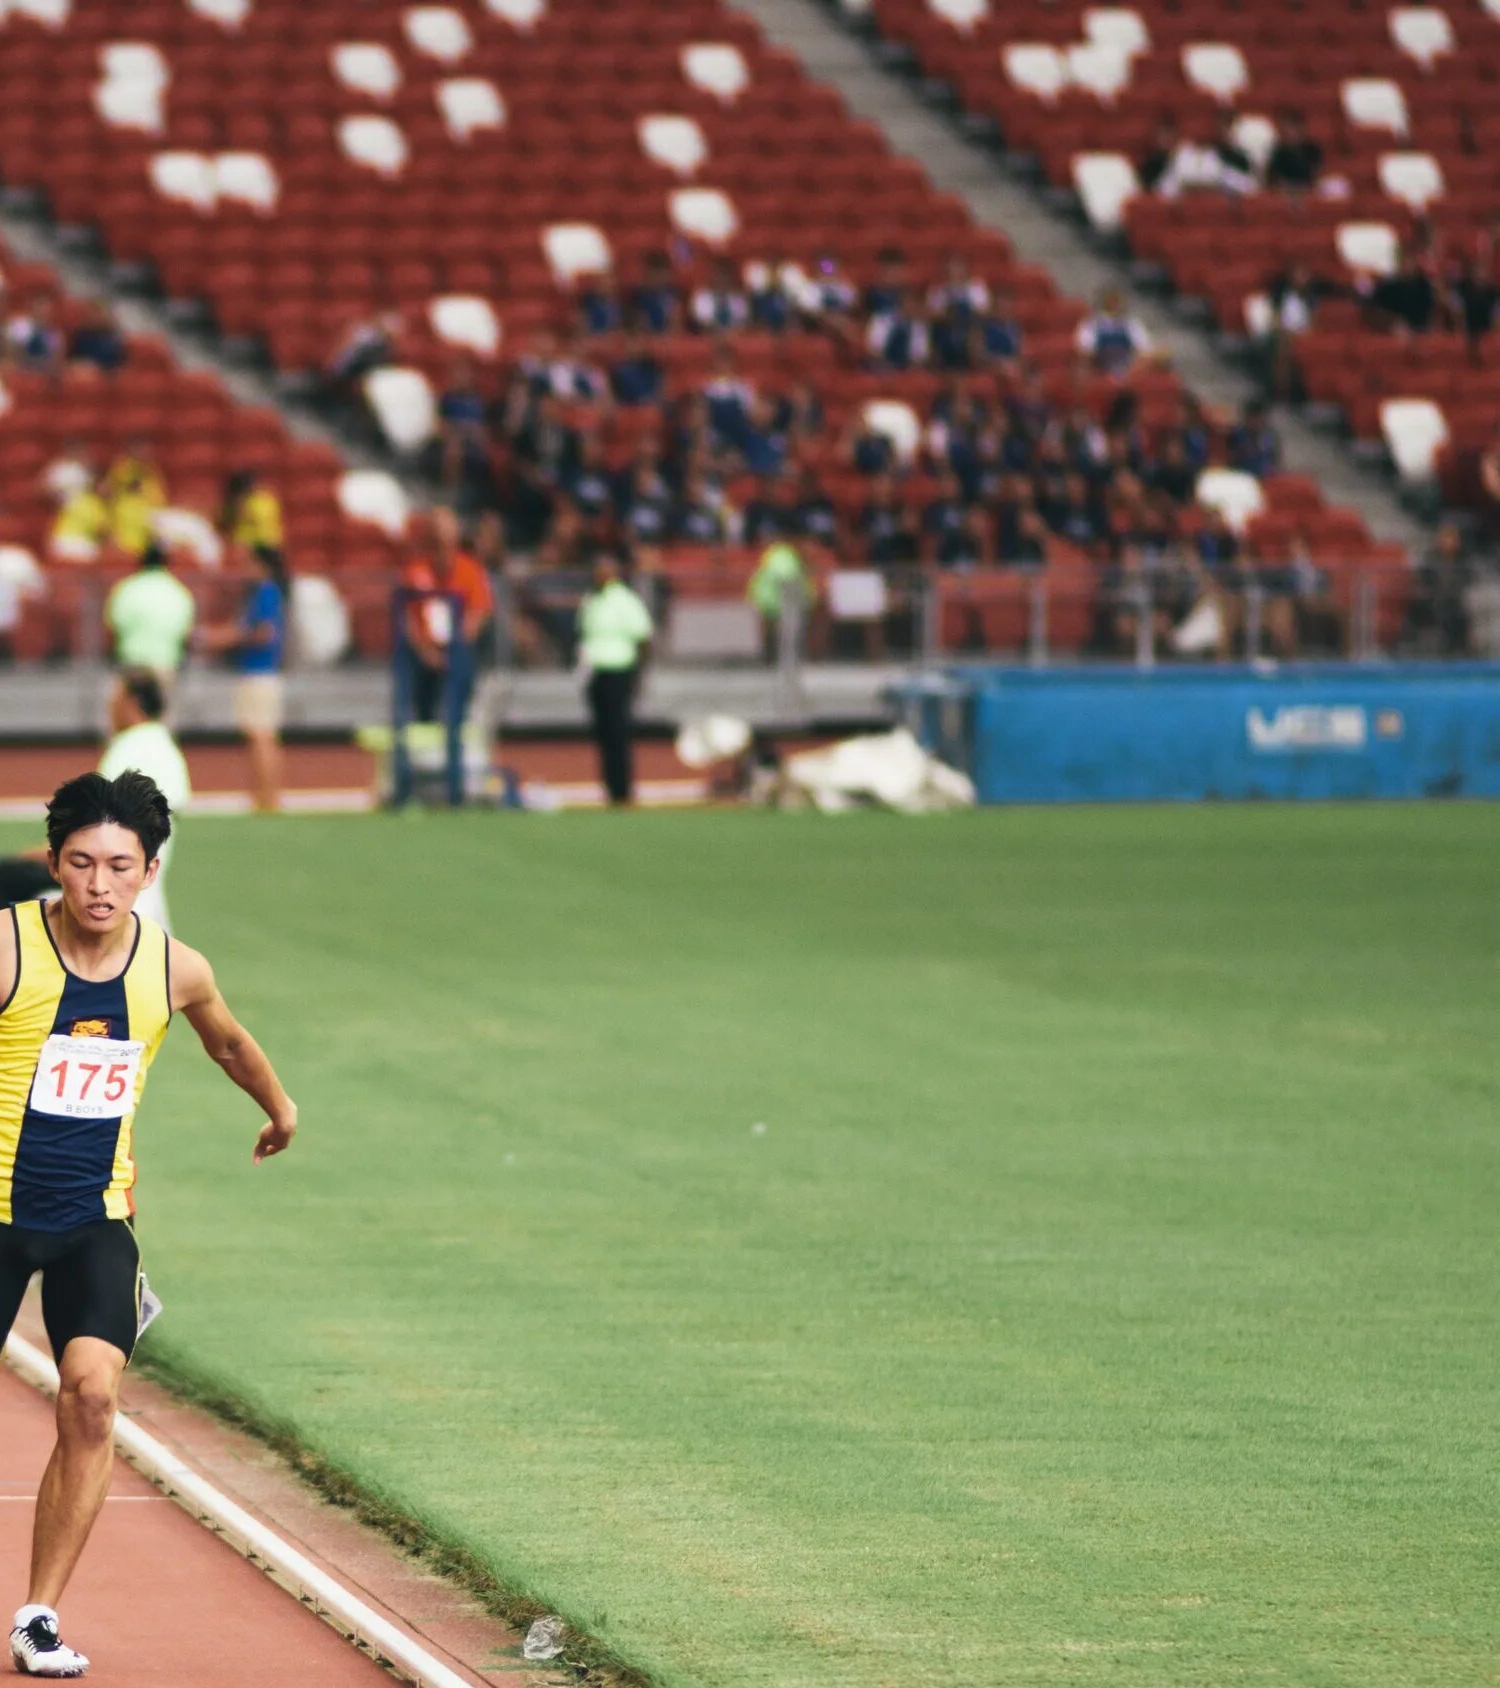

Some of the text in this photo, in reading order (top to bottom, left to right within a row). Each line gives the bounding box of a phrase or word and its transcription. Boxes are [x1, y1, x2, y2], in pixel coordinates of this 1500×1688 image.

[50, 1060, 129, 1101] 175
[66, 1104, 103, 1114] B BOYS
